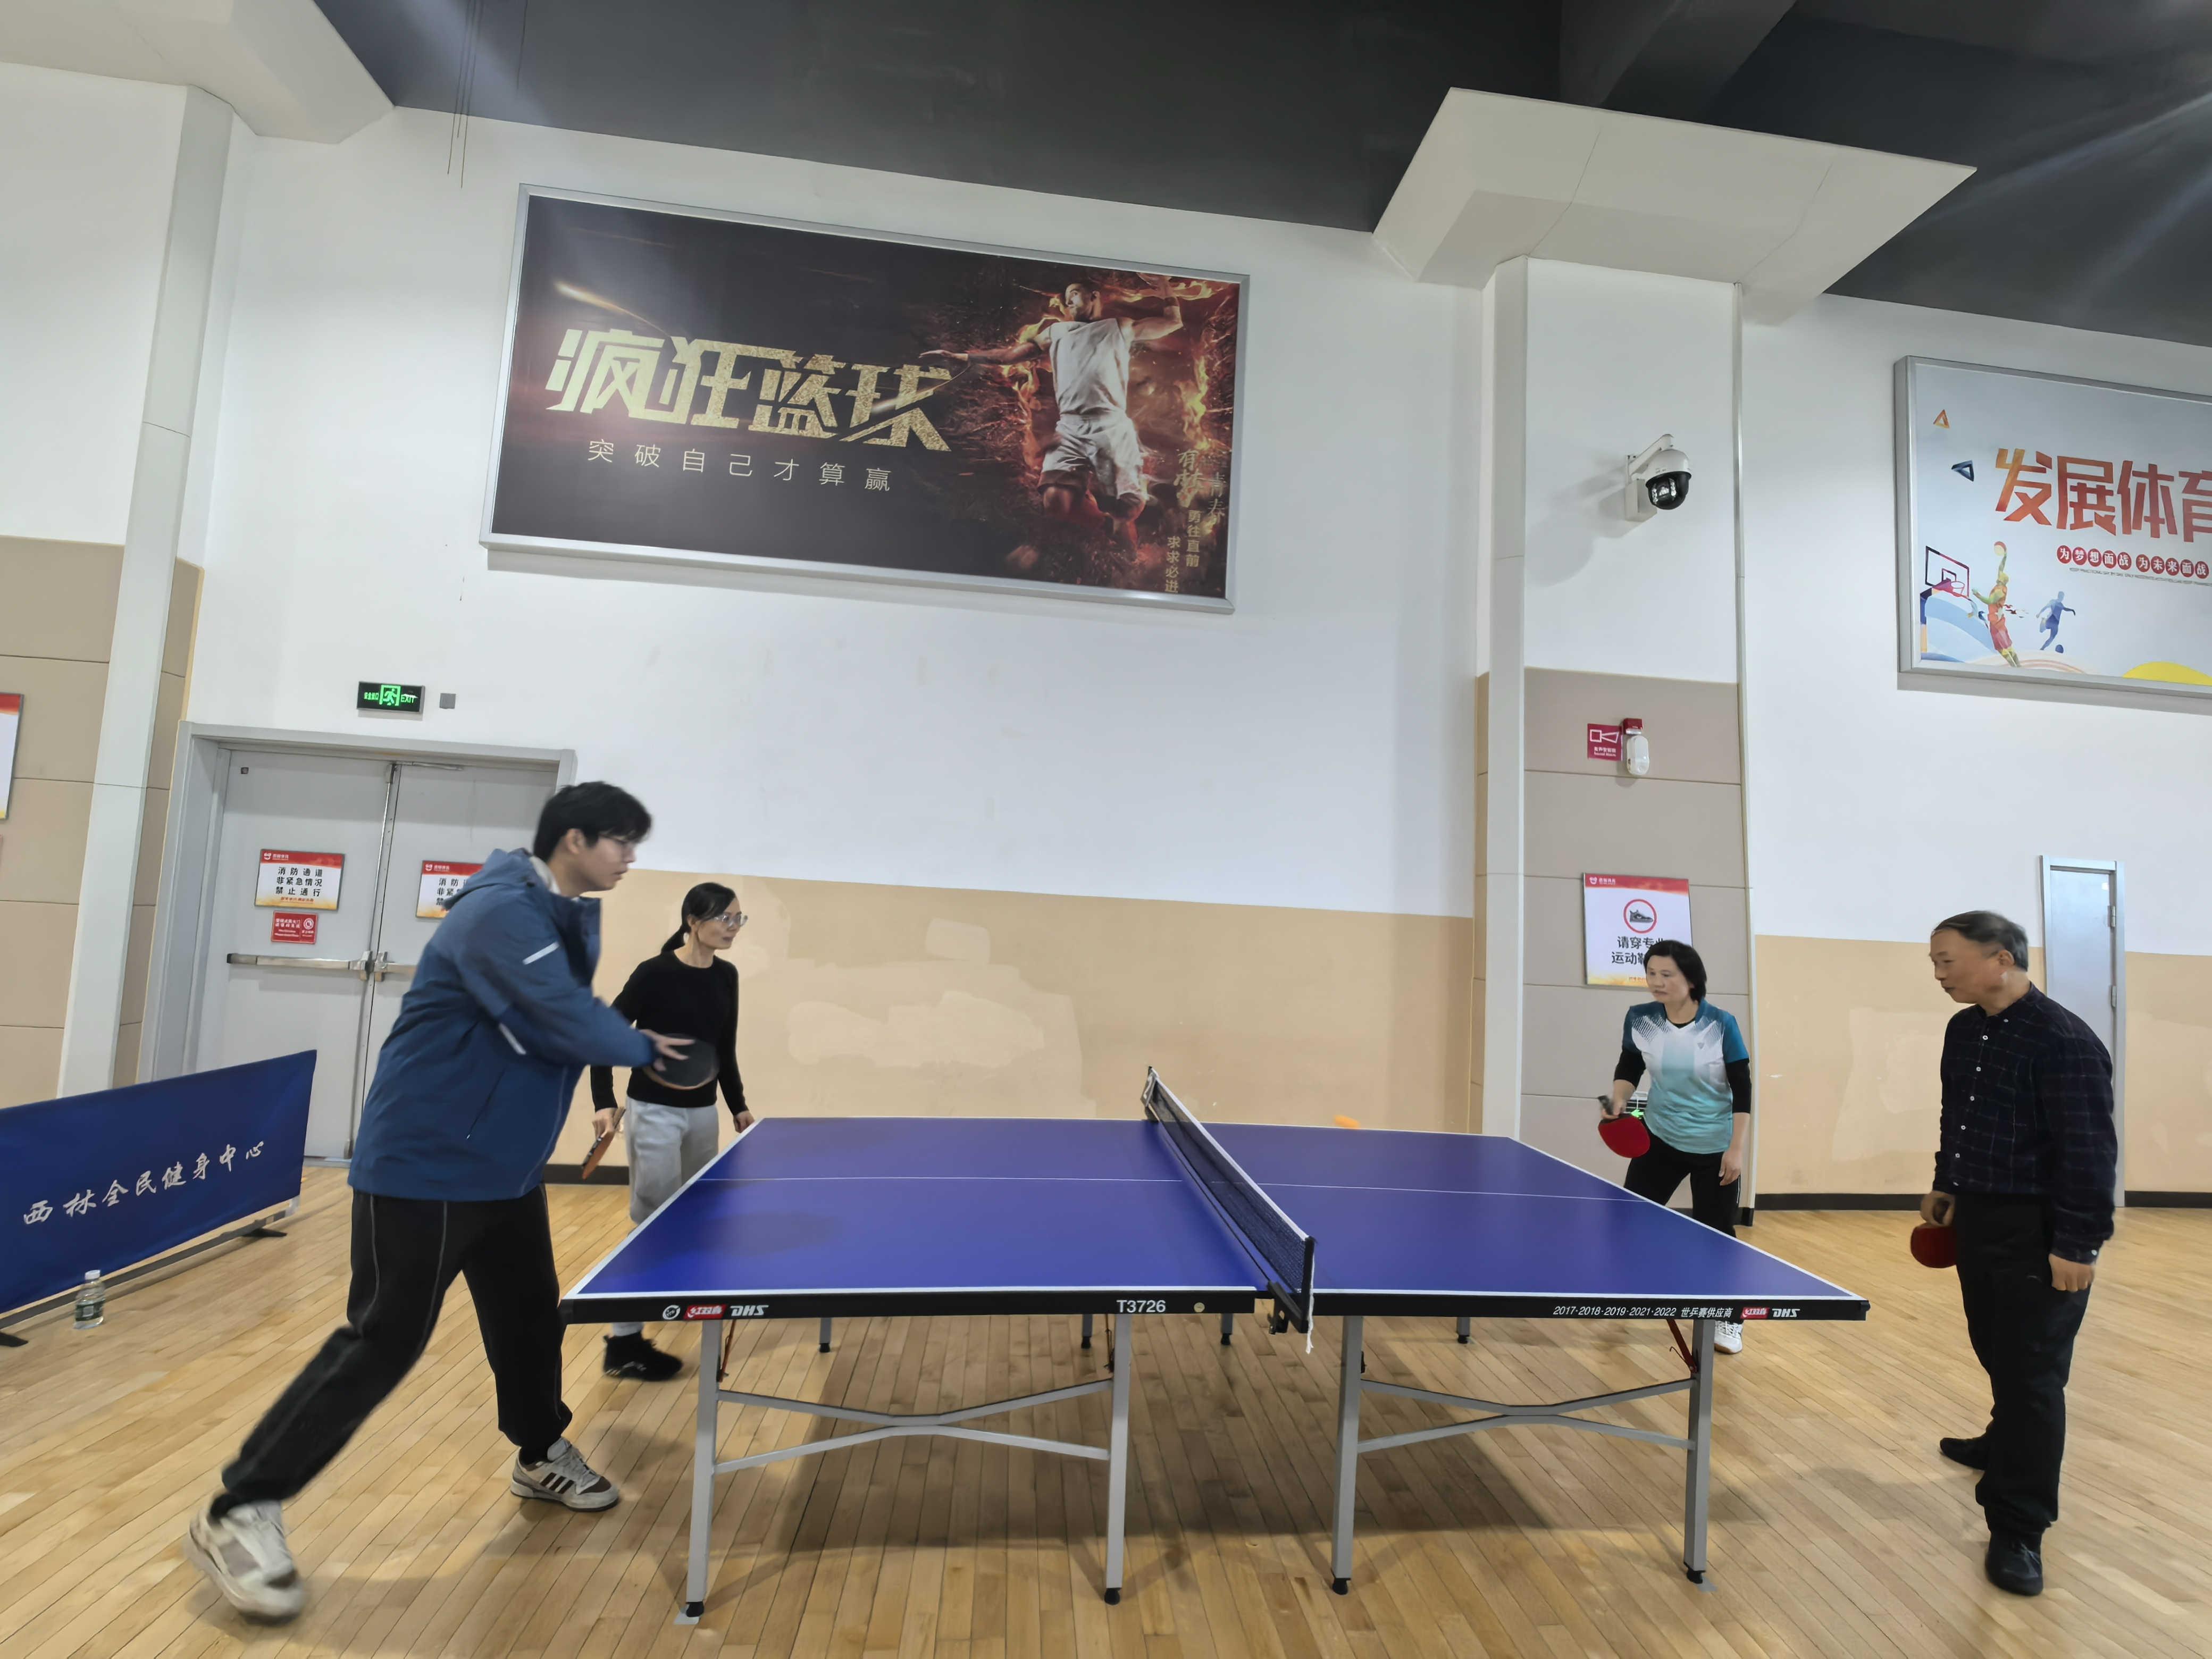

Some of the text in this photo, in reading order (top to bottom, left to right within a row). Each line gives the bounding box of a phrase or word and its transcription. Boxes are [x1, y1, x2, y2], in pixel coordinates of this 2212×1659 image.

[546, 328, 951, 451] 疯狂篮球
[588, 439, 890, 492] 突破自己才算赢
[1186, 510, 1201, 567] 勇往直前
[400, 694, 415, 703] EXIT
[278, 867, 323, 877] 消防通道
[276, 877, 322, 887] 非紧急情况
[275, 886, 321, 896] 禁止通行
[437, 887, 460, 896] 非紧
[23, 1141, 264, 1225] 西林全民健身中心
[730, 1305, 769, 1316] DHS
[1116, 1300, 1166, 1313] T3726
[1681, 1307, 1733, 1318] 世乒赛供应商
[1772, 1308, 1800, 1318] DHS
